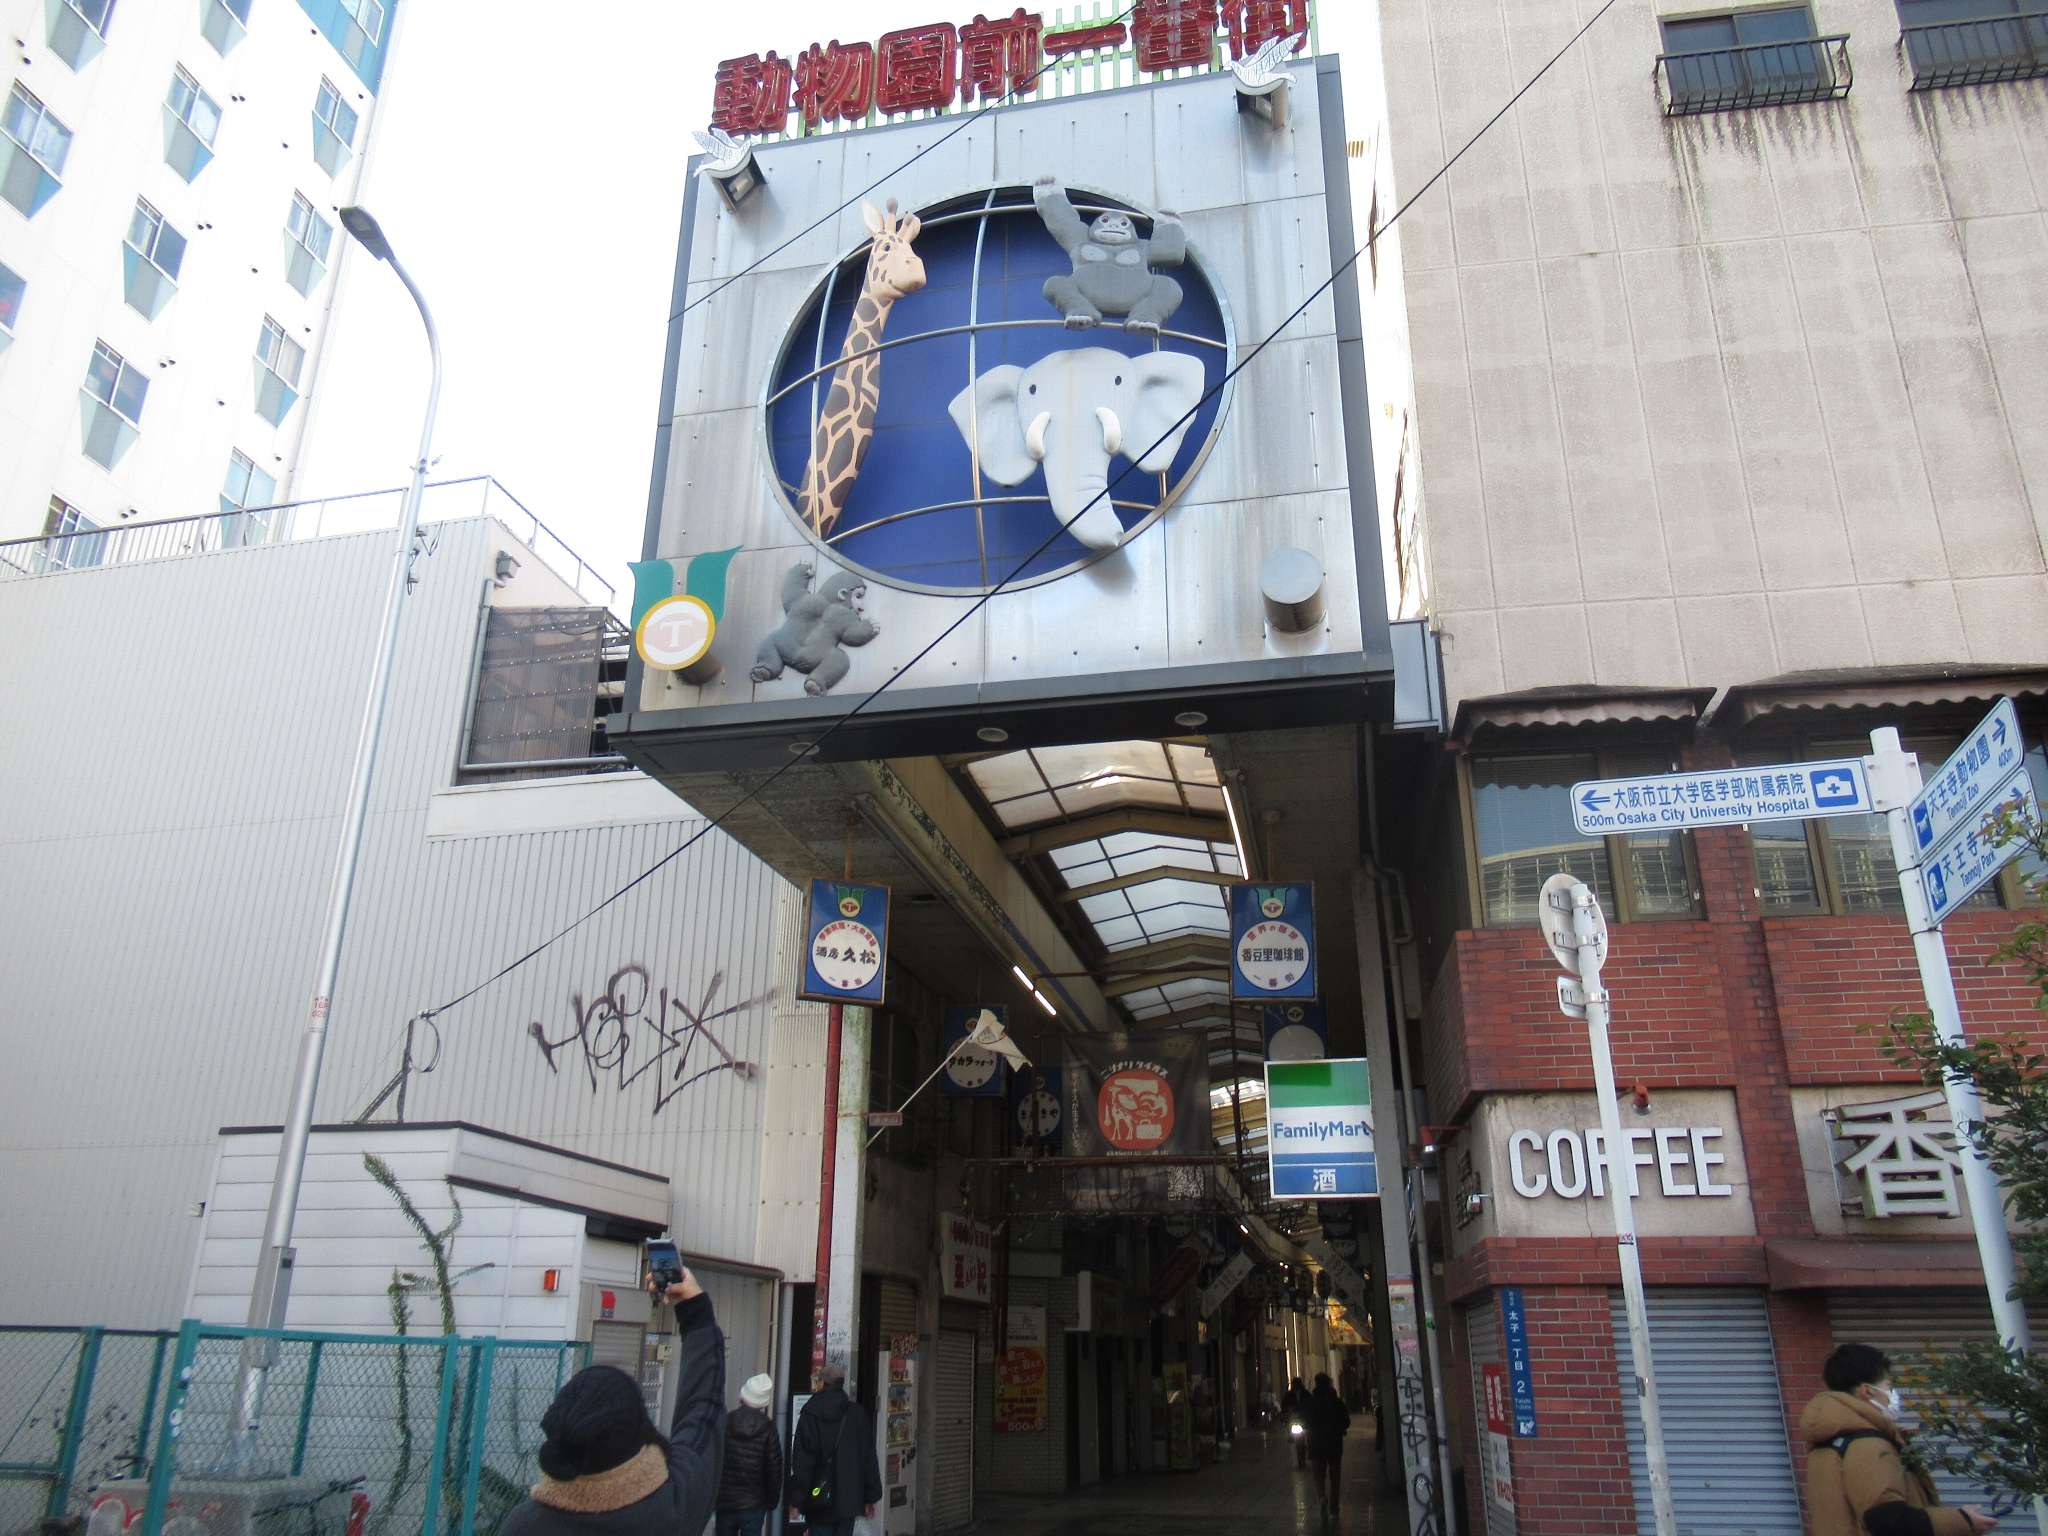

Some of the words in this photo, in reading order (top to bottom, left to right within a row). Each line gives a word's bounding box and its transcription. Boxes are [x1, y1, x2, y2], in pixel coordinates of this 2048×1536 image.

[1613, 772, 1806, 810] 大阪市立大学医学部附属病院
[1927, 733, 1990, 819] 天王寺動物園
[1582, 815, 1615, 828] 500m
[1616, 812, 1657, 826] Osaka
[1661, 809, 1686, 823] City
[1690, 803, 1753, 820] University
[1757, 797, 1810, 815] Hospital
[1273, 1120, 1370, 1142] FamilyMart
[1835, 1089, 1964, 1218] 香
[1312, 1168, 1337, 1193] 酒
[1508, 1127, 1732, 1199] COFFEE
[1508, 1310, 1523, 1371] 太子一丁目
[1516, 1380, 1526, 1393] 2
